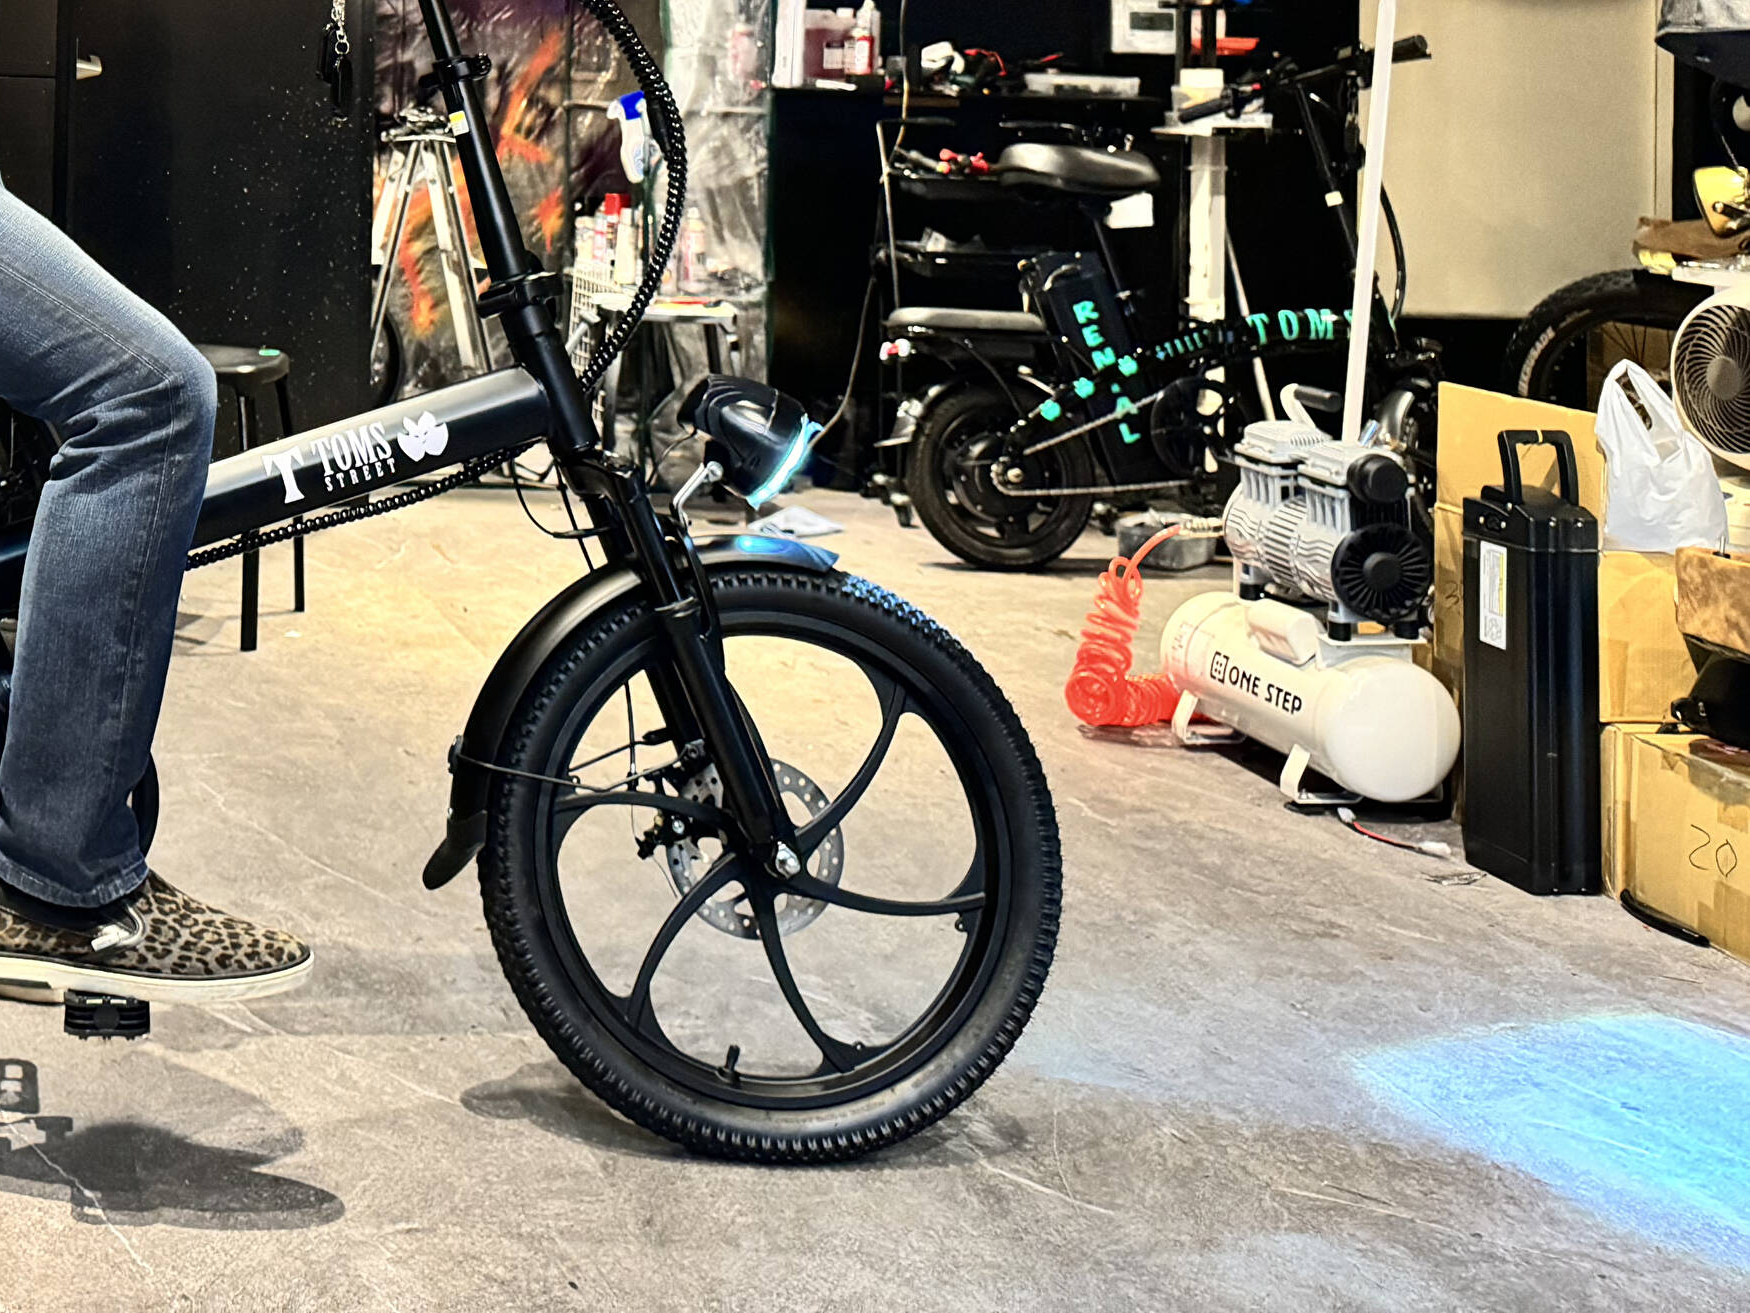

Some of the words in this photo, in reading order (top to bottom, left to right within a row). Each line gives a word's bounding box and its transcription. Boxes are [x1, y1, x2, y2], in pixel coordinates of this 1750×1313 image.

[1073, 300, 1142, 444] RENAL
[310, 420, 393, 477] TOMS
[323, 457, 396, 493] STREET
[1228, 666, 1261, 697] ONE
[1264, 683, 1303, 715] STEP
[1688, 823, 1738, 878] 20
